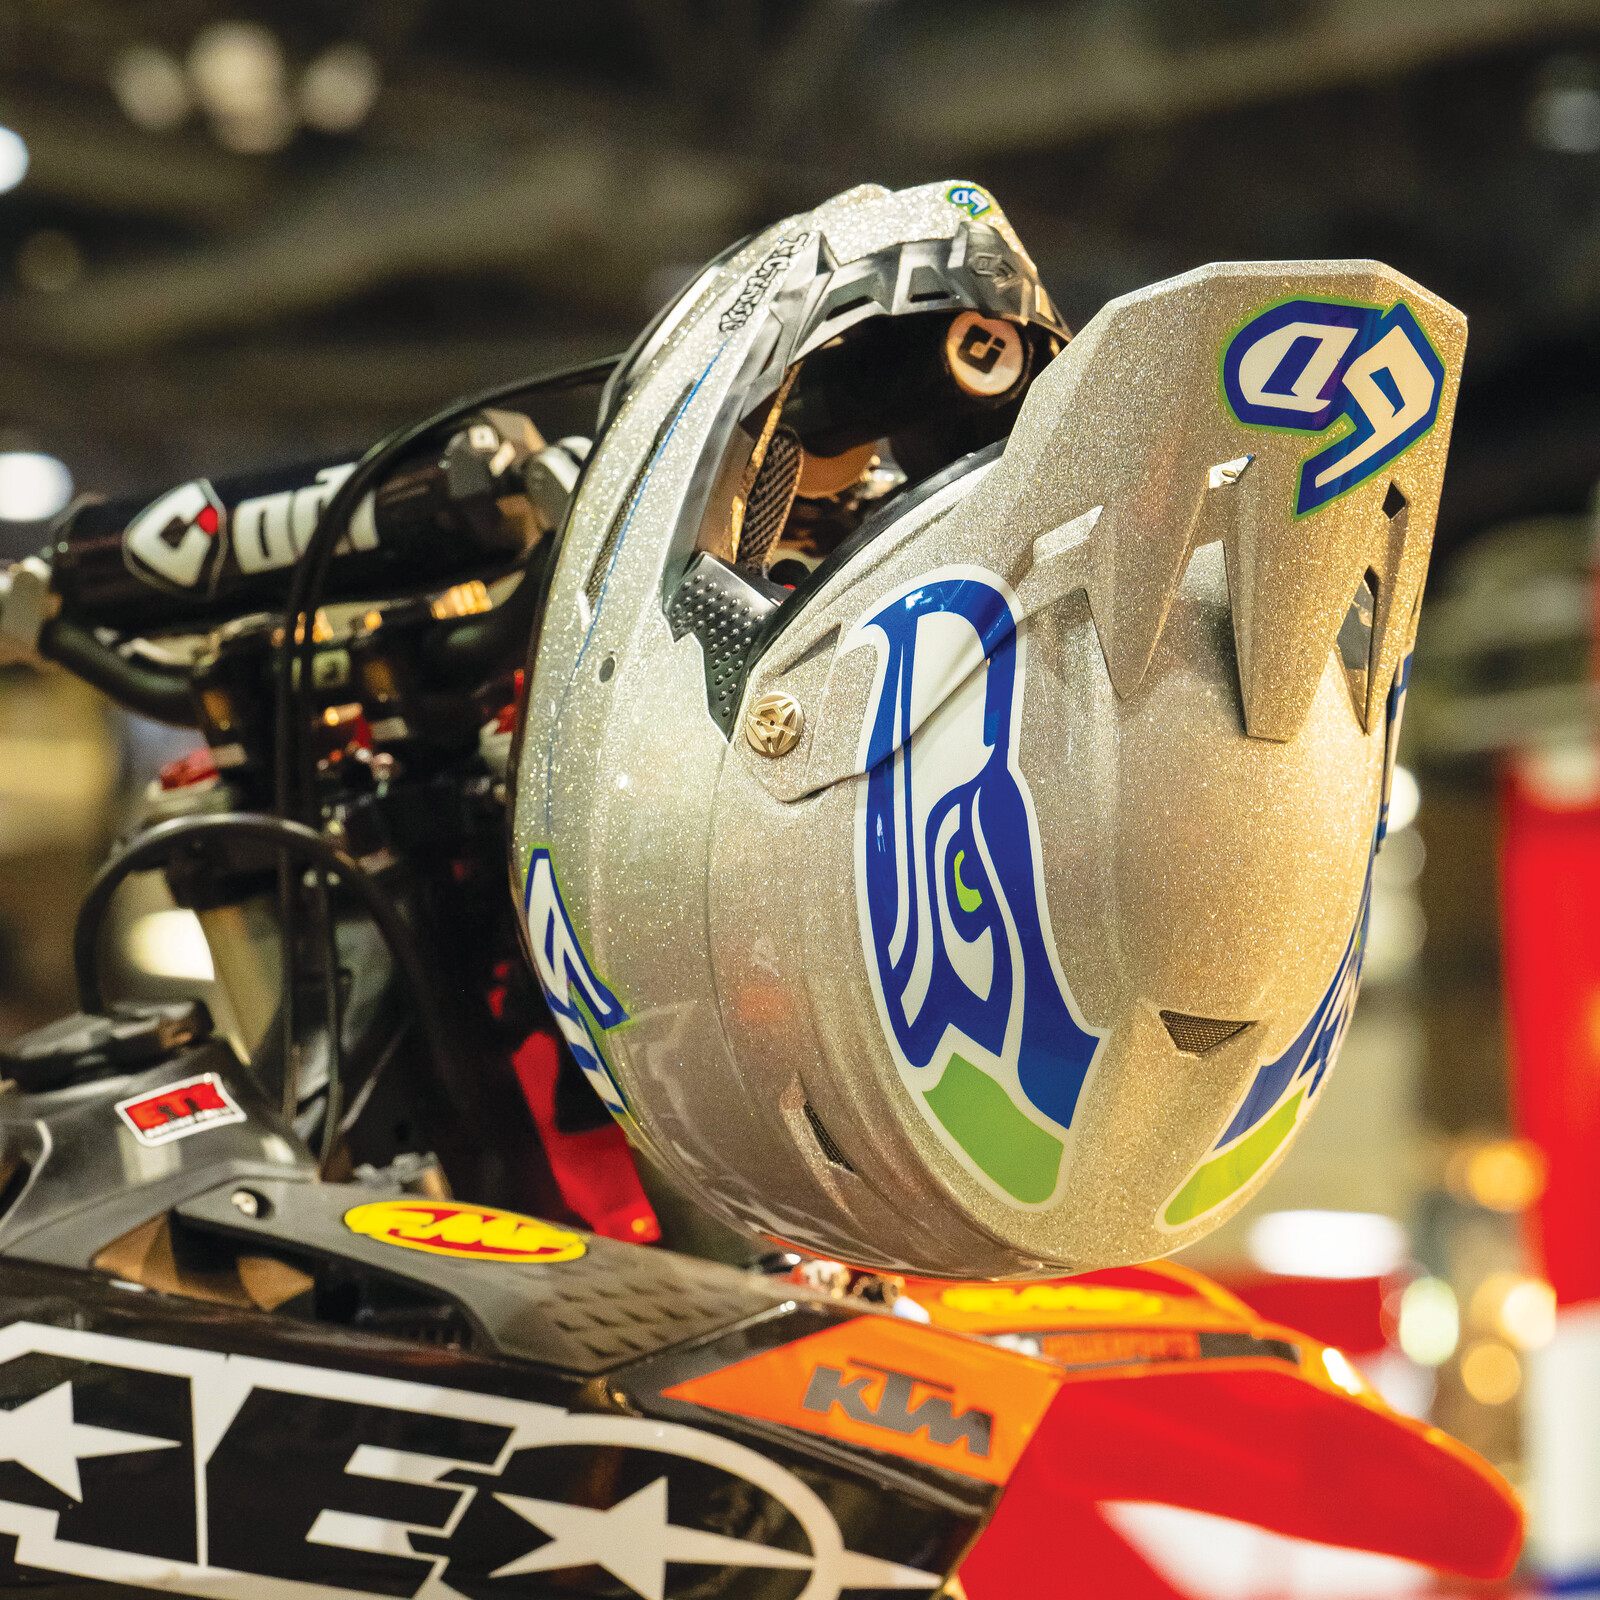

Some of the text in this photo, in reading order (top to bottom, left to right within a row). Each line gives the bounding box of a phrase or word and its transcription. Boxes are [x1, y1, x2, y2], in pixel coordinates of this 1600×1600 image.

[1229, 306, 1440, 505] 6D
[346, 1205, 588, 1256] FMF
[802, 1358, 993, 1458] KTM
